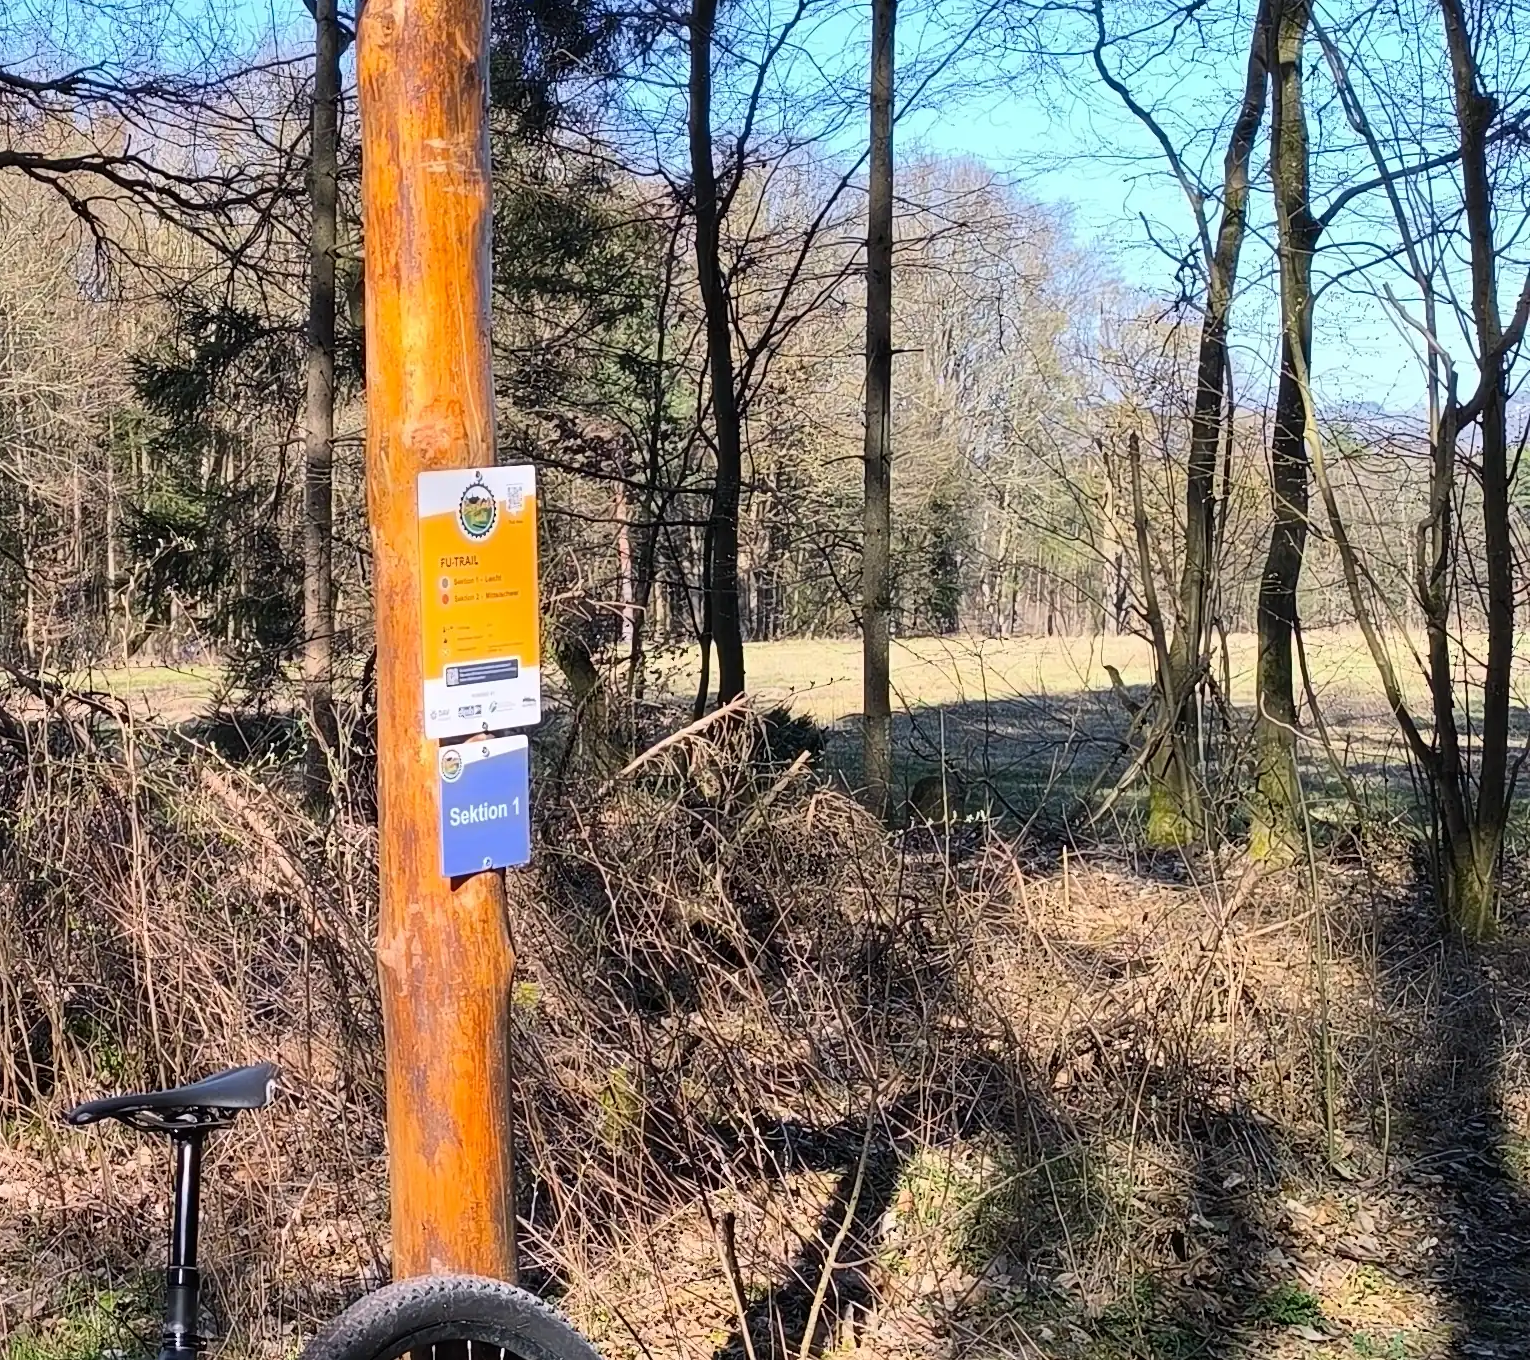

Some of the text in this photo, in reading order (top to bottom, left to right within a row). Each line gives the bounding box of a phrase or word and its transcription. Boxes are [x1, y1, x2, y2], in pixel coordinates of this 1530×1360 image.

[440, 555, 479, 568] FU-TRAIL
[450, 796, 520, 826] Sektion 1
